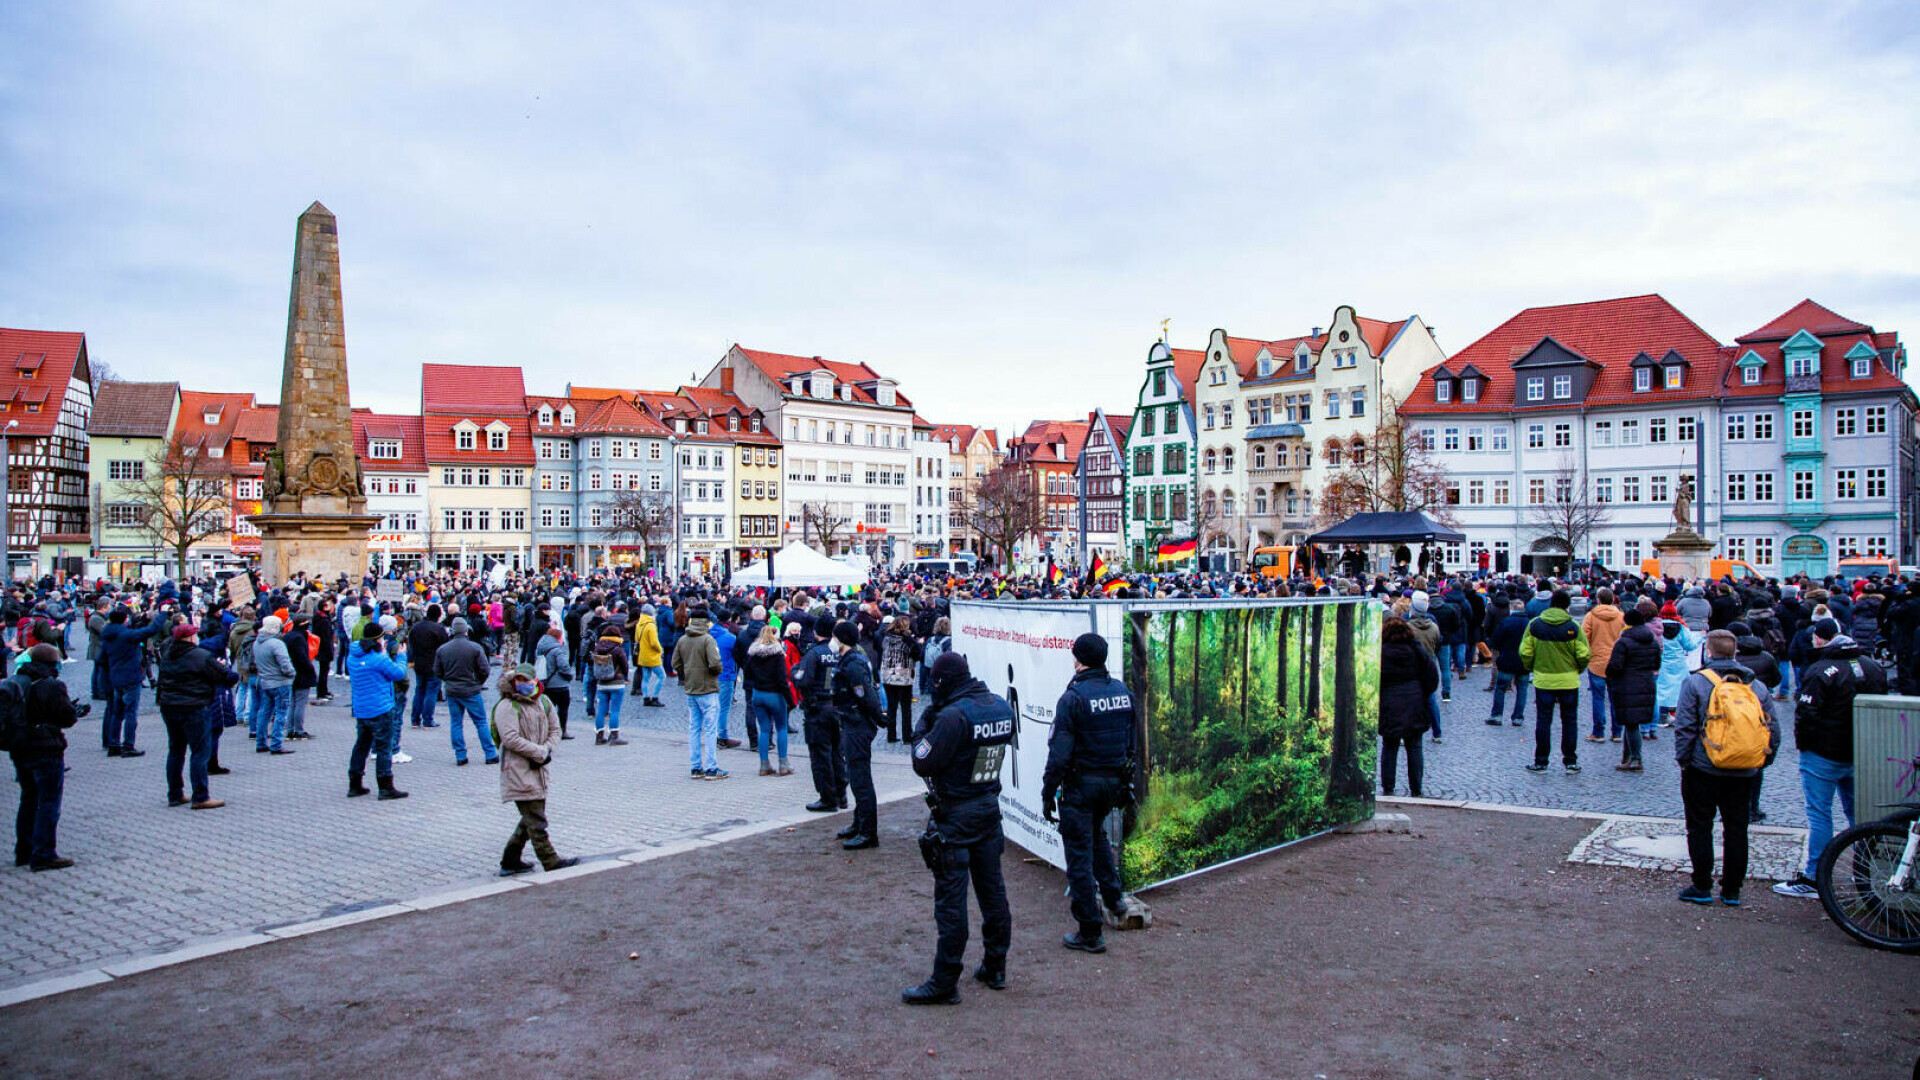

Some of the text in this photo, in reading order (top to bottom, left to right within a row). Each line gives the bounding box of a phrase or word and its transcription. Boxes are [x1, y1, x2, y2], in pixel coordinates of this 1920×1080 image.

[1090, 694, 1132, 713] POLIZEI
[973, 719, 1012, 740] POLIZEI
[986, 746, 999, 758] TH
